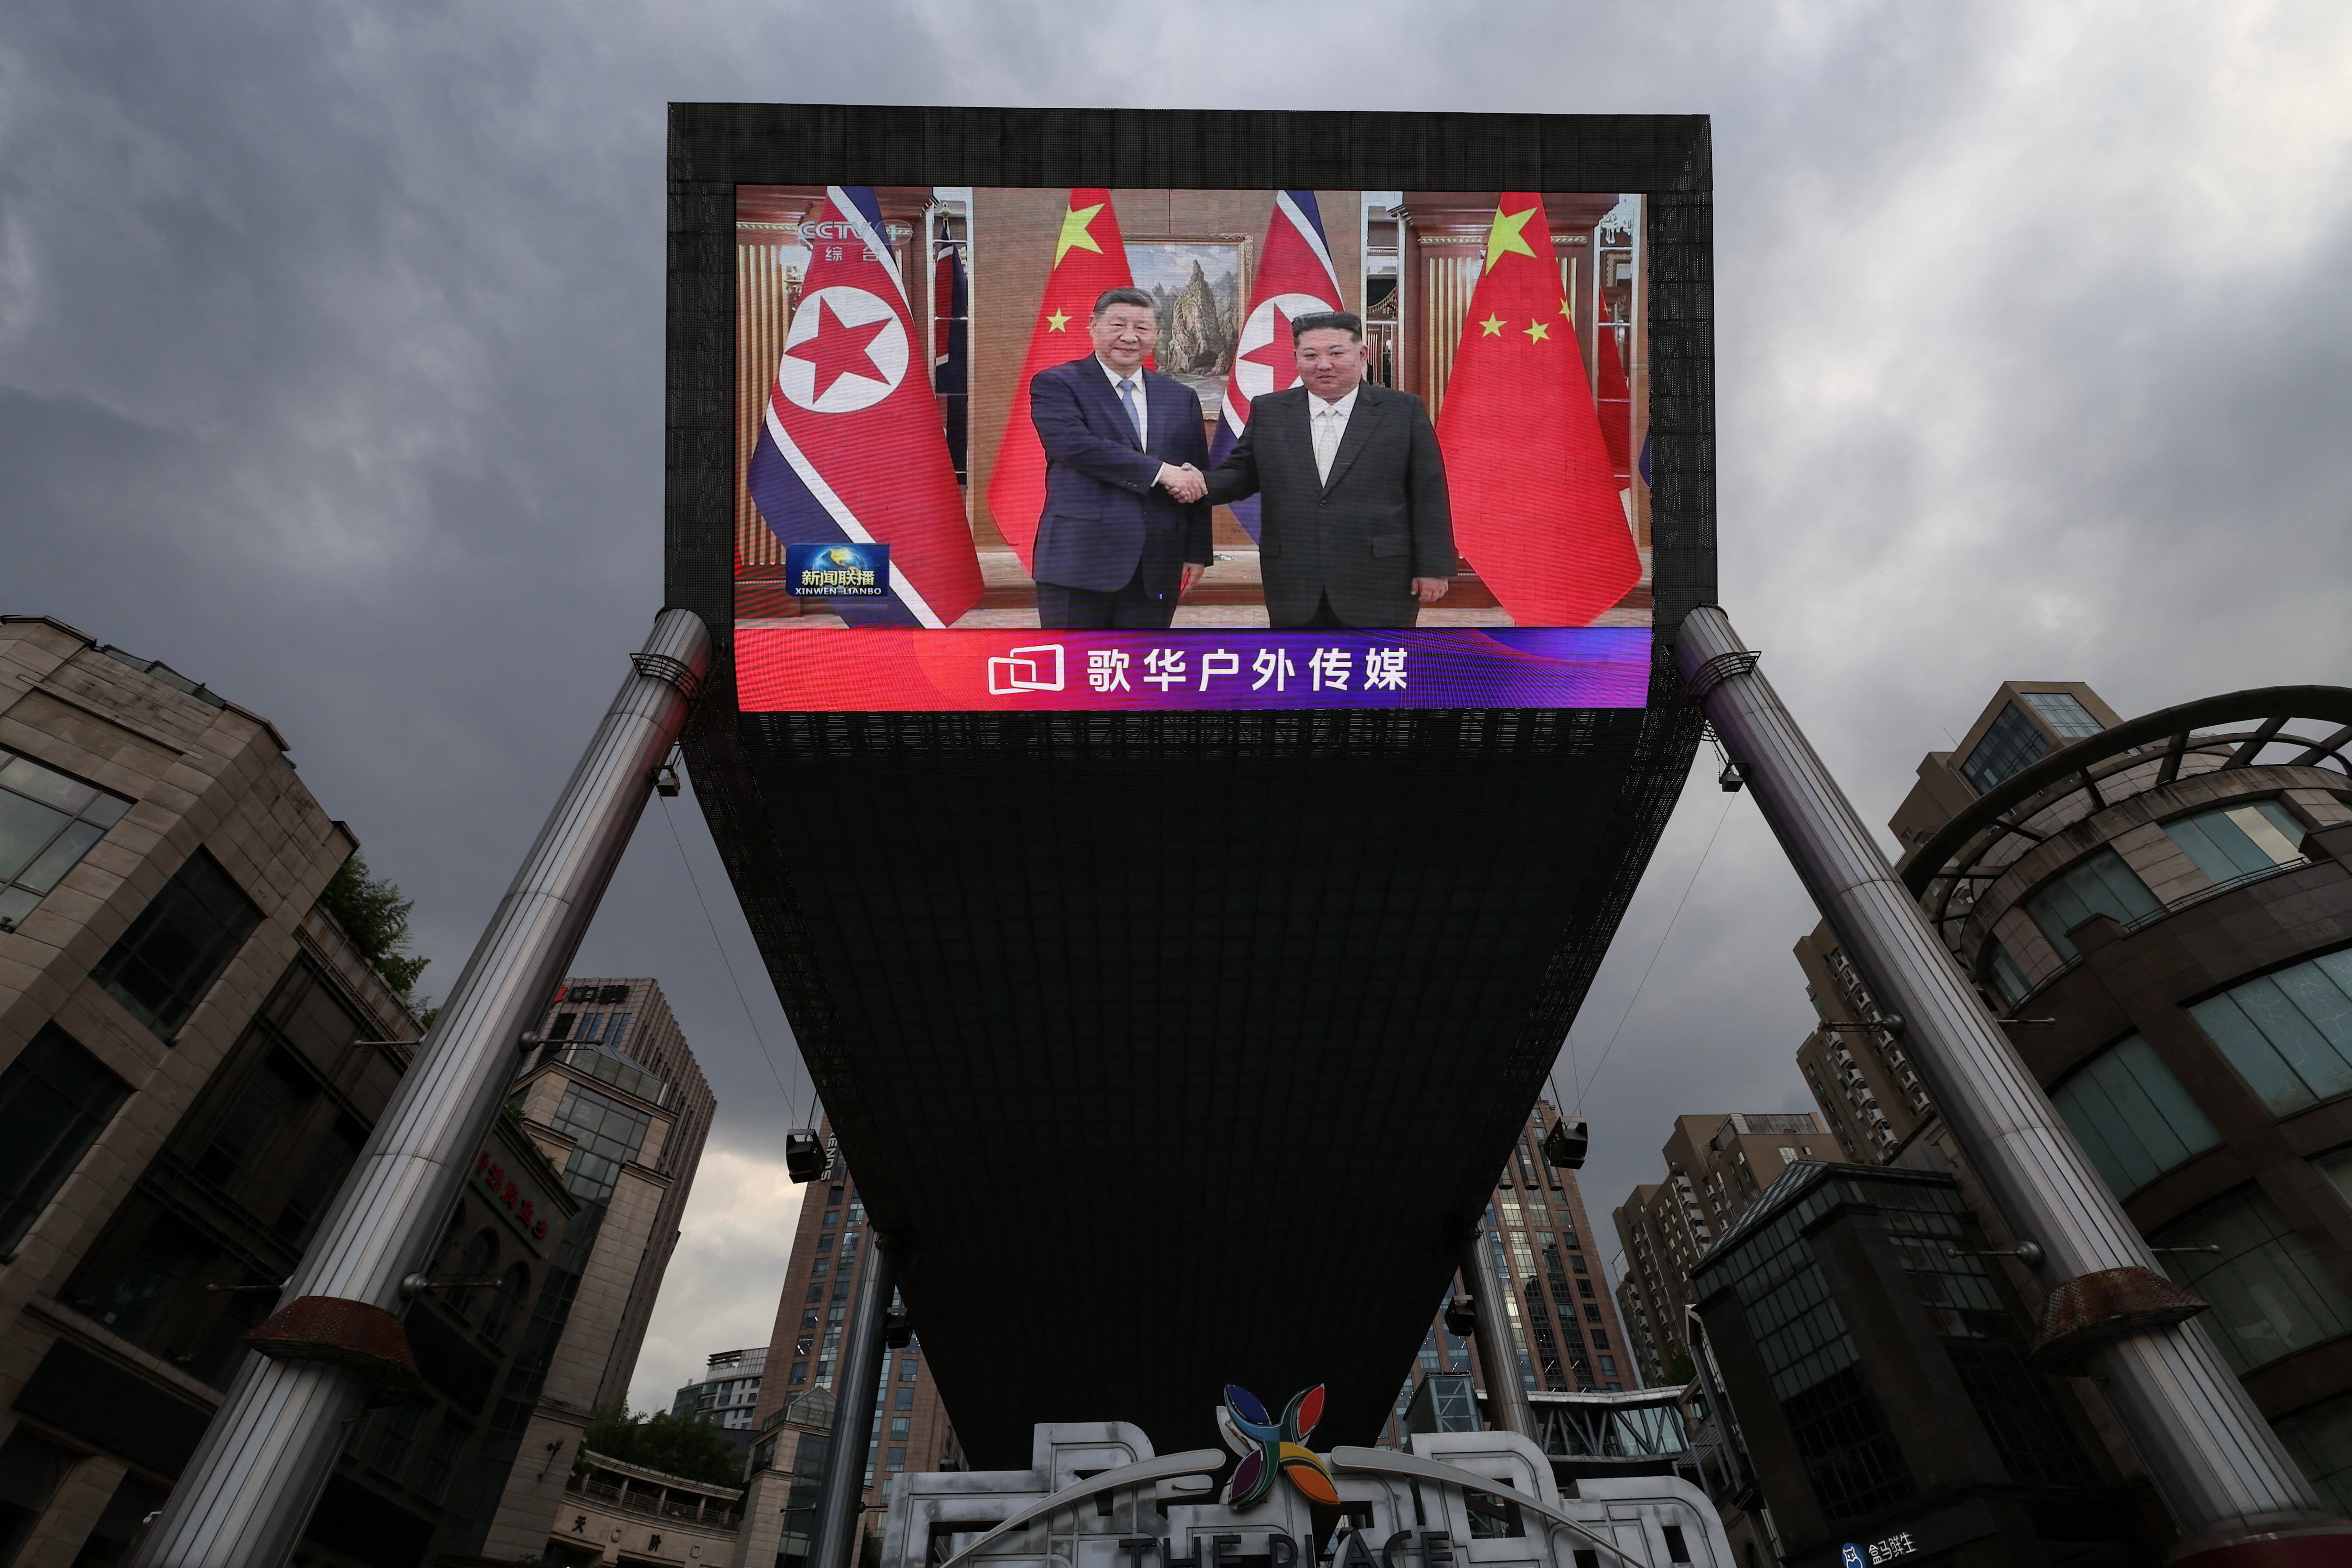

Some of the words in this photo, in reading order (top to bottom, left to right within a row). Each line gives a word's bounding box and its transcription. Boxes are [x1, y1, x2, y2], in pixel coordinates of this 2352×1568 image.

[797, 222, 872, 239] CCTV
[825, 246, 879, 261] 综合
[802, 570, 875, 586] 新闻联播
[1087, 648, 1408, 692] 歌华户外传媒
[1868, 1532, 1918, 1566] 盒马鲜生
